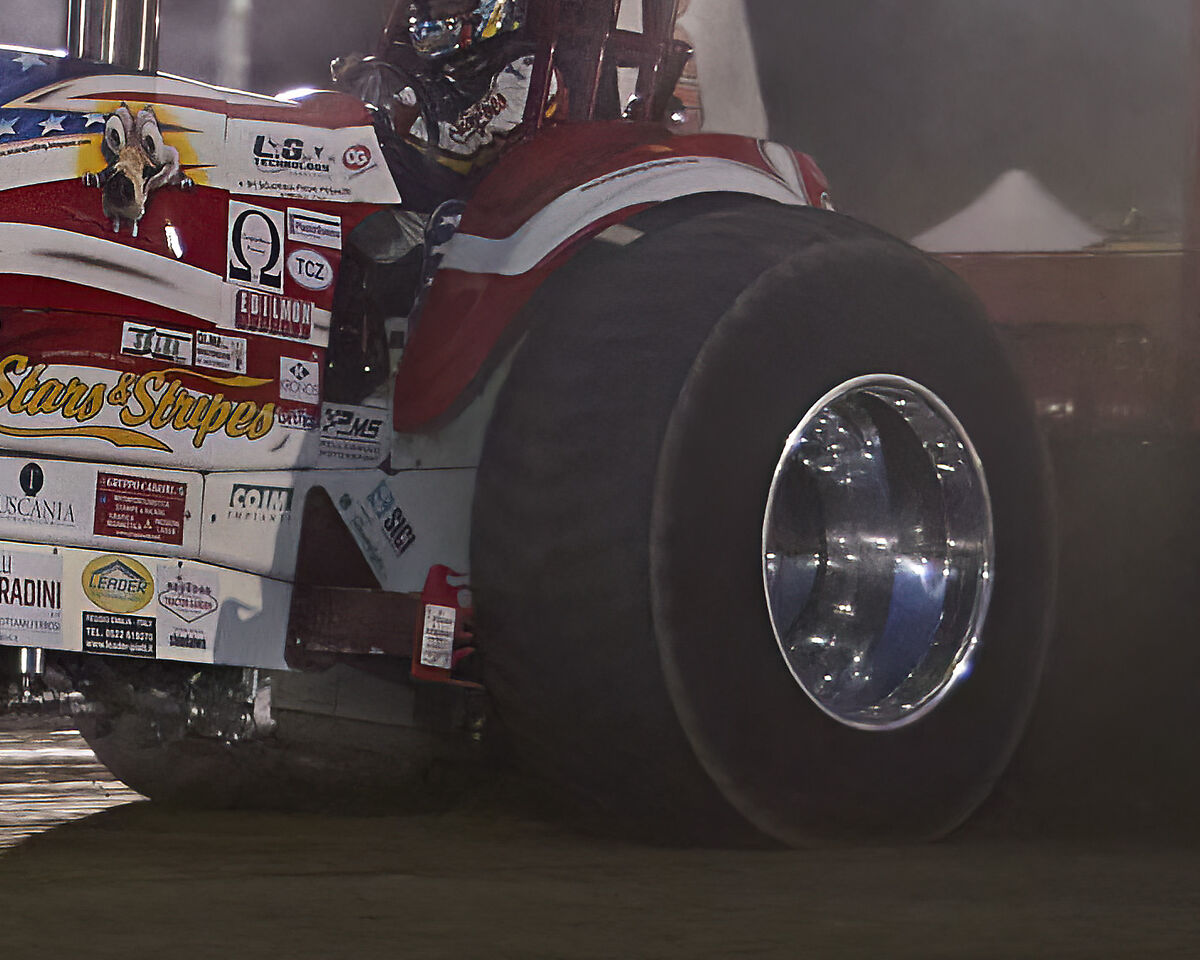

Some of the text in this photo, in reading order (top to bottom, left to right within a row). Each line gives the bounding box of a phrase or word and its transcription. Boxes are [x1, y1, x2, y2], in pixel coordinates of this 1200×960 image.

[295, 257, 325, 281] TCZ
[106, 372, 138, 407] &
[120, 374, 276, 448] Stripes
[233, 487, 288, 512] COIM
[89, 574, 149, 594] LEADER
[86, 627, 104, 637] TEL.
